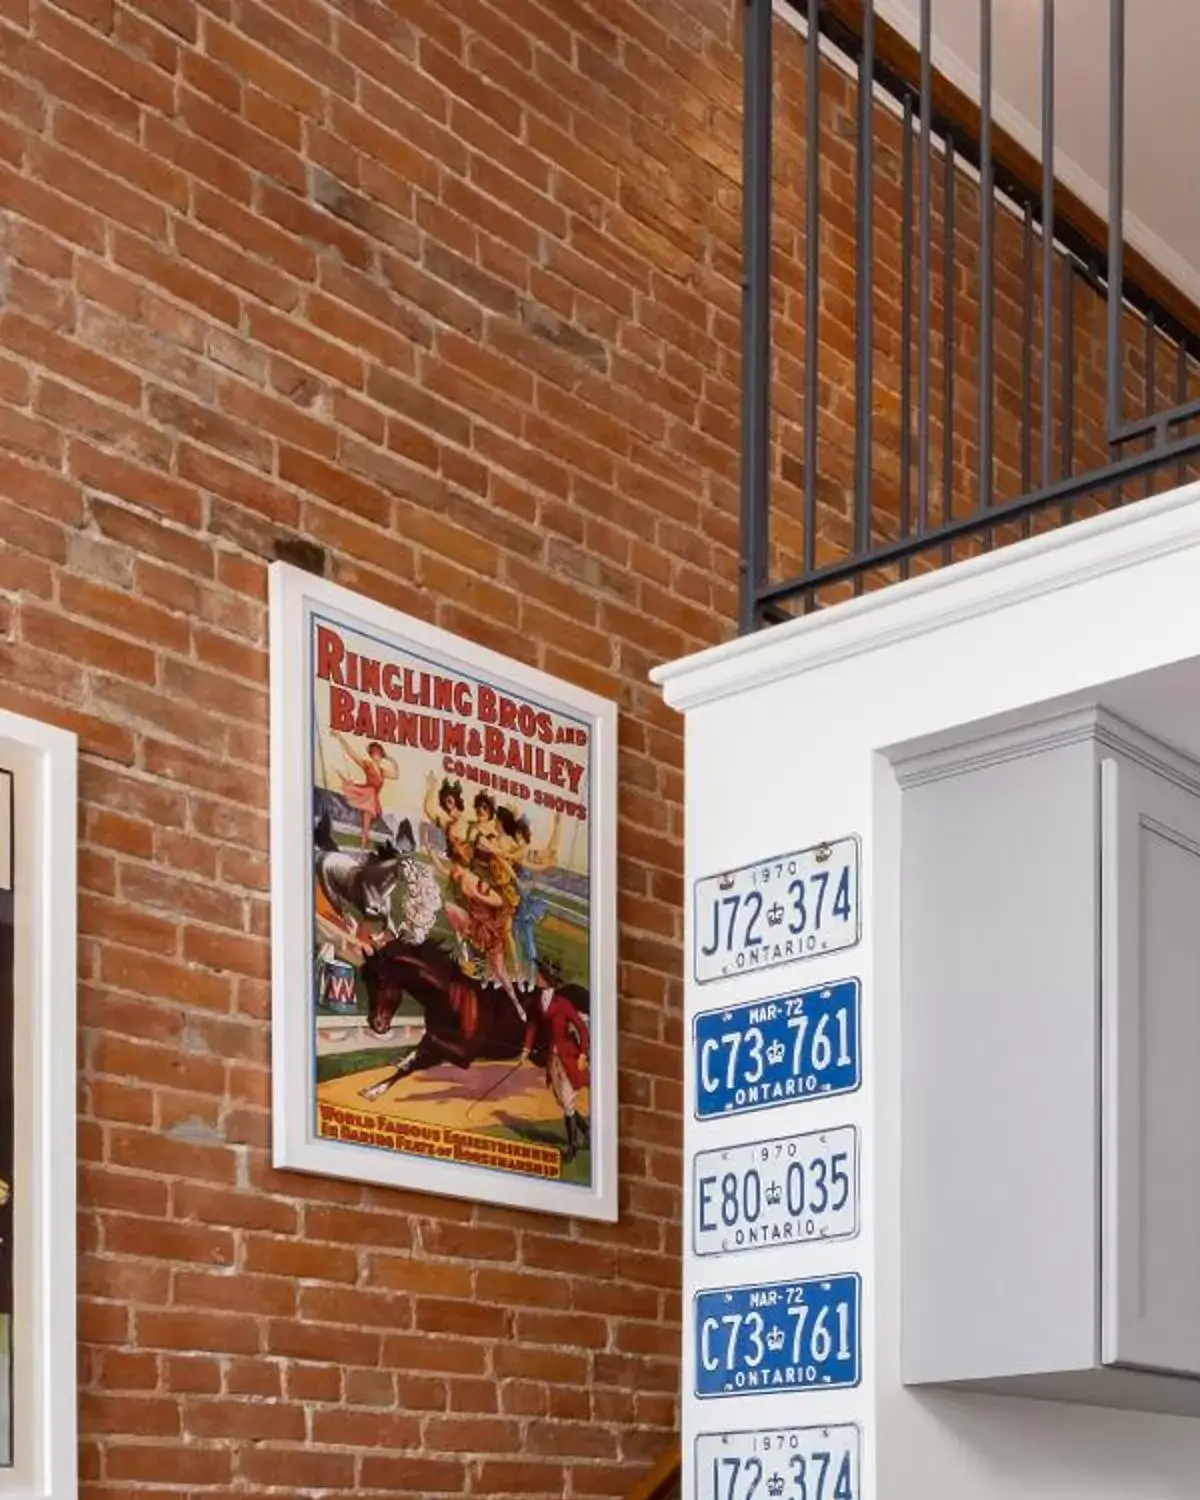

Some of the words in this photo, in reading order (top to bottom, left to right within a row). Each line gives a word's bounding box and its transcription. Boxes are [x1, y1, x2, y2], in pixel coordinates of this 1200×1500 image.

[316, 624, 473, 717] RINGLING
[477, 684, 553, 745] BROS
[555, 727, 588, 747] AND
[329, 687, 467, 757] BARNUM
[483, 725, 585, 795] BAILEY
[442, 755, 531, 801] COMBINED
[533, 790, 588, 821] SHOWS
[701, 890, 763, 957] J72
[787, 865, 851, 934] 374
[735, 935, 816, 968] ONTARIO
[749, 1000, 803, 1025] MAR-72
[700, 1026, 764, 1094] C73
[787, 1008, 851, 1075] 761
[735, 1073, 817, 1106] ONTARIO
[377, 1116, 441, 1142] FAMOUS
[700, 1168, 761, 1232] E80
[735, 1220, 816, 1246] ONTARIO
[749, 1288, 803, 1307] MAR-72
[700, 1312, 764, 1371] C73
[787, 1302, 851, 1362] 761
[735, 1366, 817, 1387] ONTARIO
